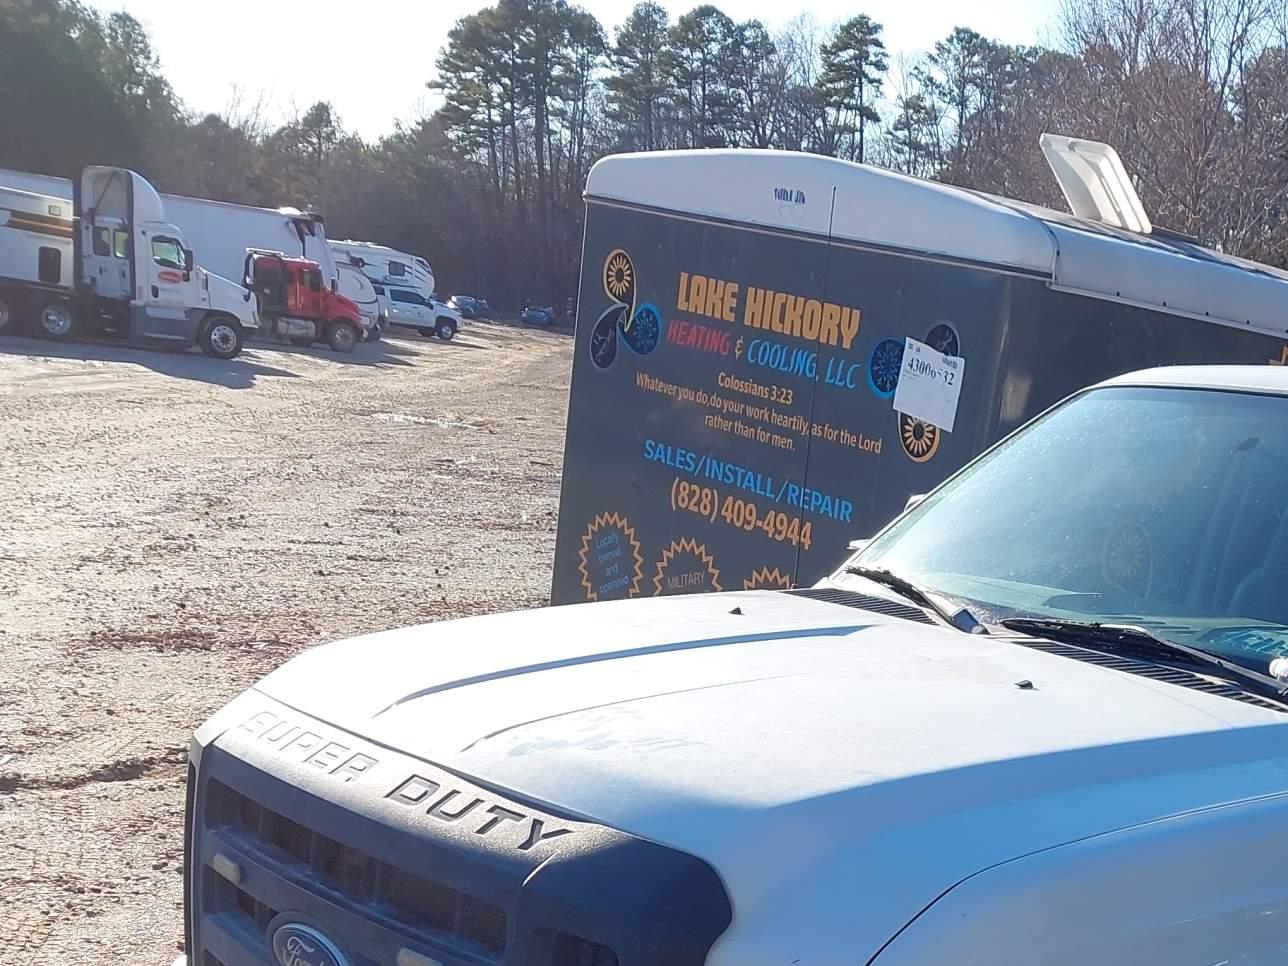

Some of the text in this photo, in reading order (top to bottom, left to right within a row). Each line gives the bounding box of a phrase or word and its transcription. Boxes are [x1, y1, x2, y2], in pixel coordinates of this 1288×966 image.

[677, 271, 861, 350] LAKE HICKORY
[666, 319, 862, 389] HEATING & COOLING, LLC
[718, 371, 793, 405] Colossians 3:23
[908, 357, 956, 386] 430032
[636, 371, 677, 397] Whatever
[677, 387, 695, 401] you
[723, 399, 745, 415] your
[745, 405, 769, 423] work
[770, 408, 810, 436] heartily,
[811, 422, 823, 436] as
[823, 423, 838, 441] for
[840, 429, 857, 447] the
[858, 433, 882, 454] Lord
[704, 415, 796, 452] rather than for men.
[671, 477, 812, 550] (828) 409-4944
[667, 571, 705, 590] MILITARY
[237, 711, 575, 851] SUPER DUTY
